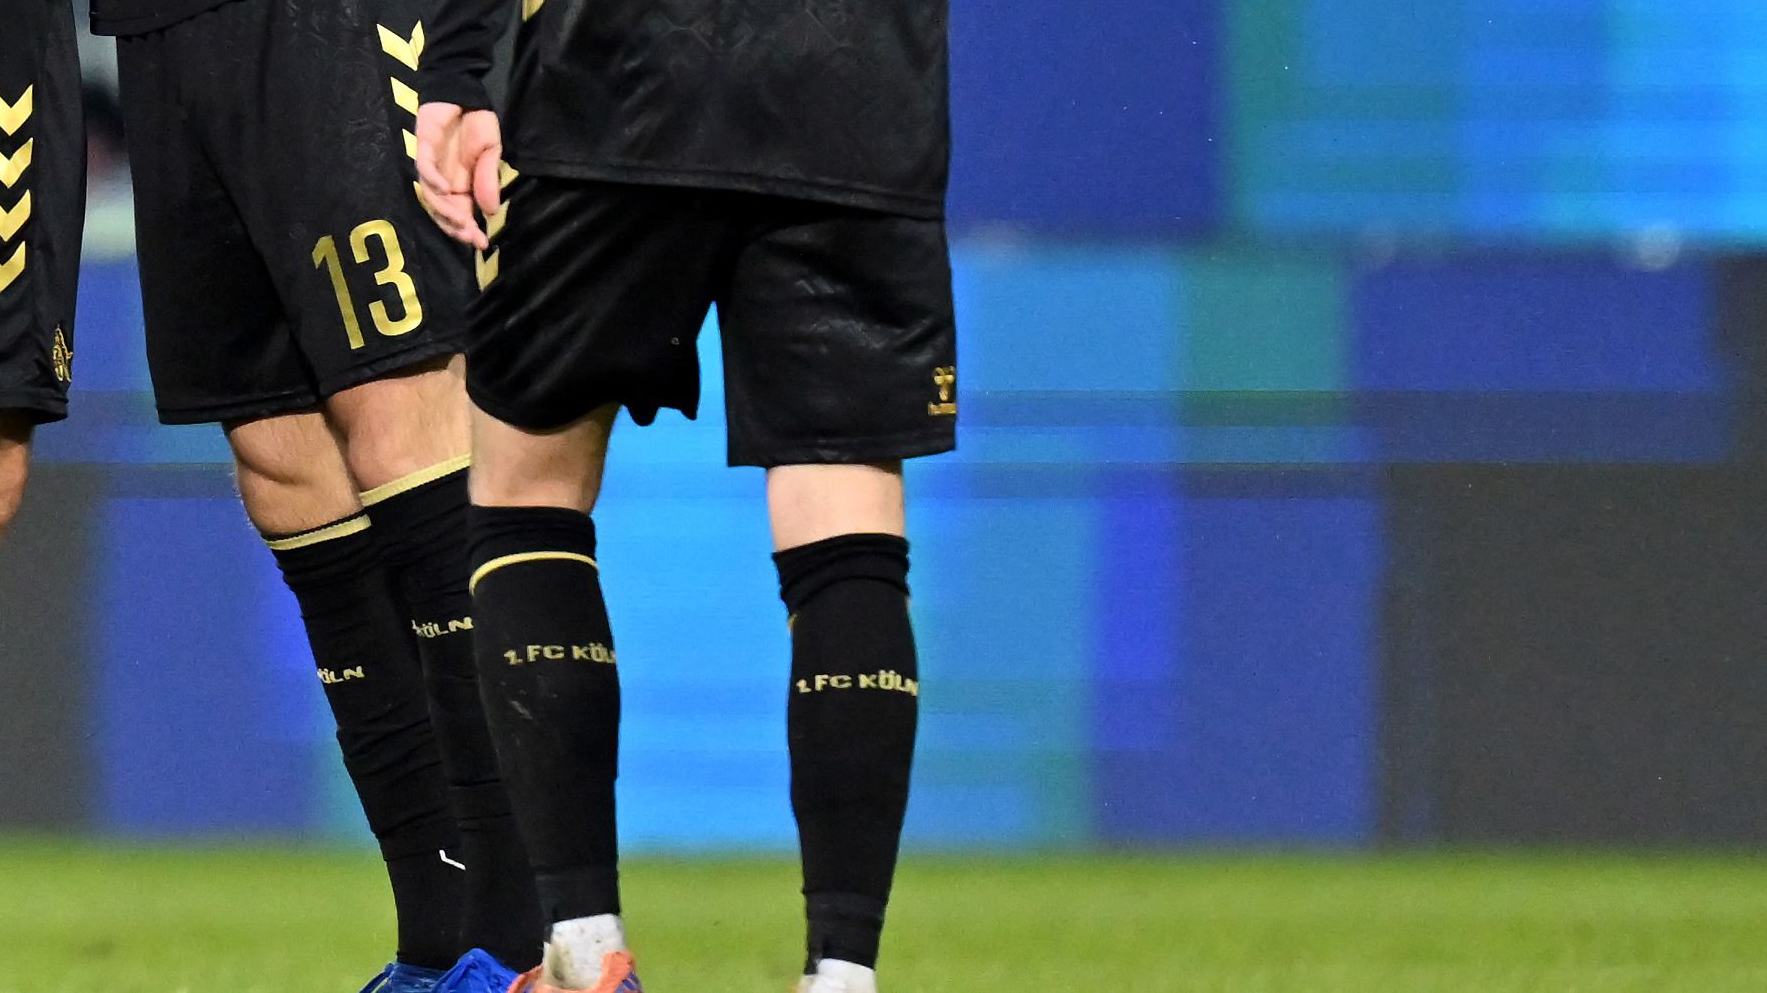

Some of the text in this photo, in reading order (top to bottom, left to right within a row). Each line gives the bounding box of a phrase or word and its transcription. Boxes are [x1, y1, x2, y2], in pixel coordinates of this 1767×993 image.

[311, 219, 423, 350] 13
[572, 642, 616, 663] KÖL
[317, 666, 365, 684] ÖLN
